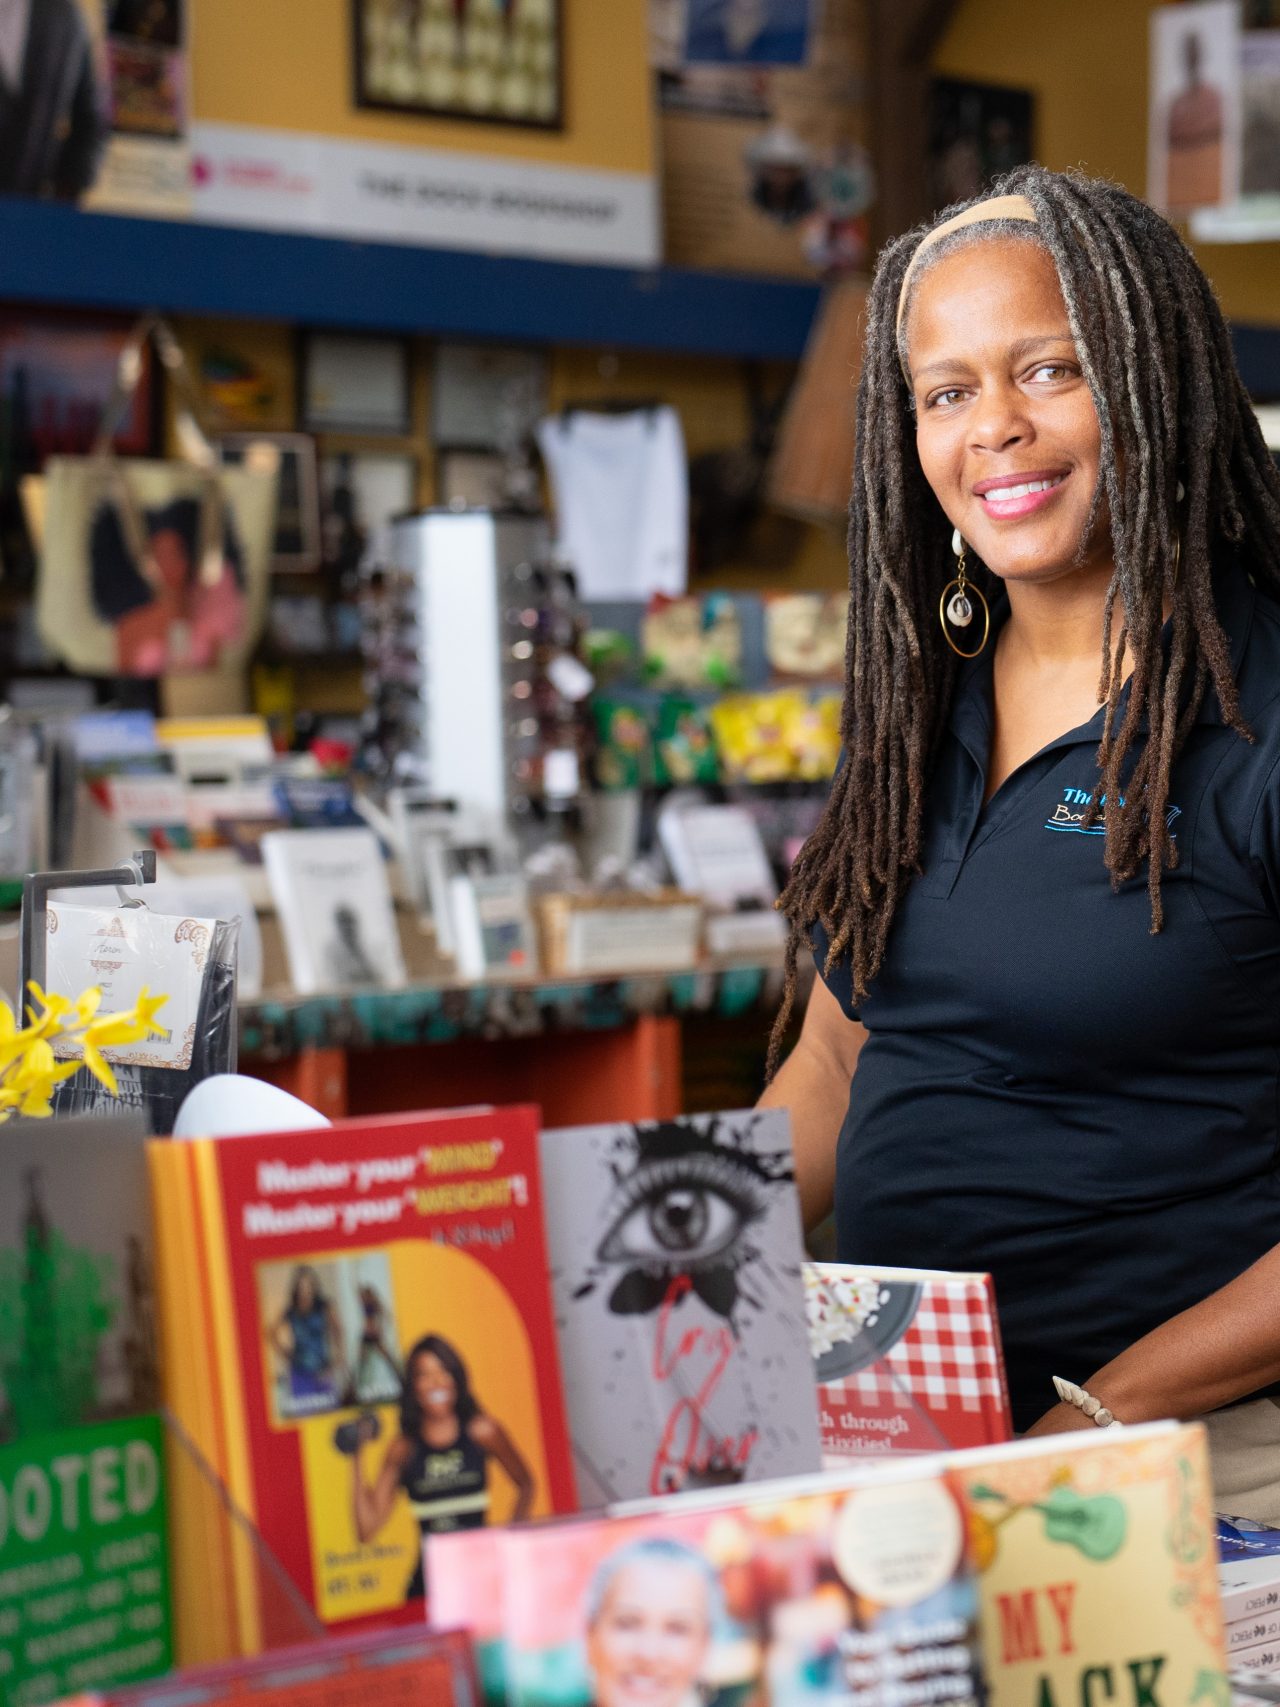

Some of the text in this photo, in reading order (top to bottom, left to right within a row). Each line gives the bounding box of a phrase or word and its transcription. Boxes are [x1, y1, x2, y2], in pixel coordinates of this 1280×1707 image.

[257, 1159, 350, 1195] Master
[354, 1153, 418, 1192] your
[243, 1202, 338, 1237] Master
[341, 1194, 403, 1234] your
[840, 1411, 909, 1437] through
[0, 1439, 160, 1546] OTED
[998, 1580, 1077, 1664] MY
